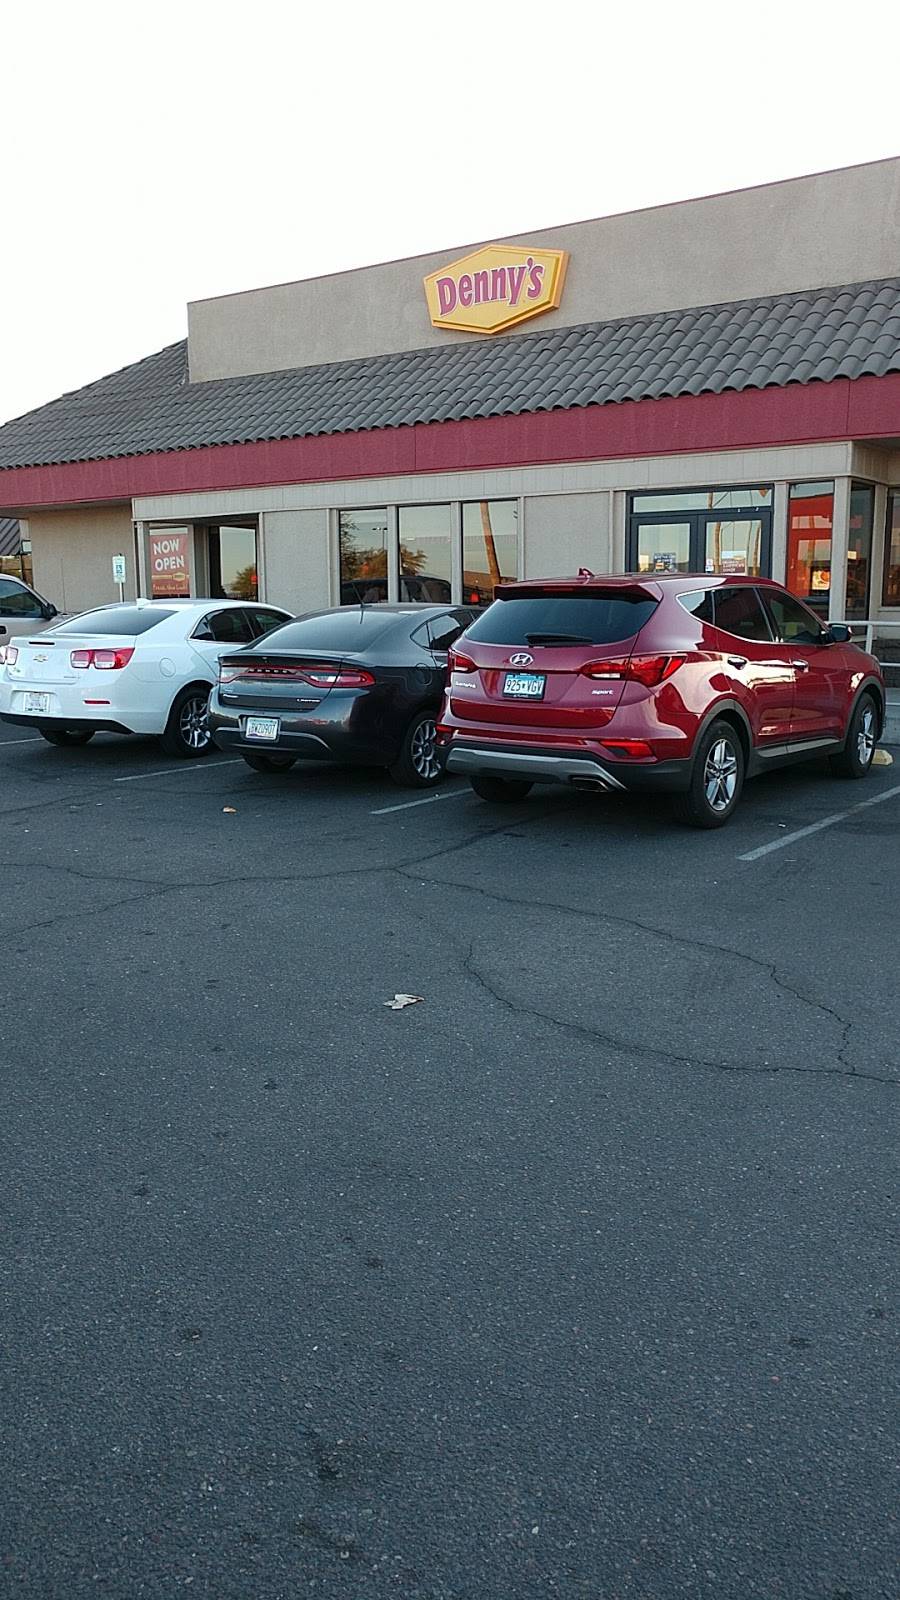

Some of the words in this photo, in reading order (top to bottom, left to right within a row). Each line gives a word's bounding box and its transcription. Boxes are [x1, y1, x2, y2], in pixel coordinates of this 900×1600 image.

[435, 256, 545, 317] Denny's
[153, 539, 180, 555] NOW
[154, 555, 185, 571] OPEN
